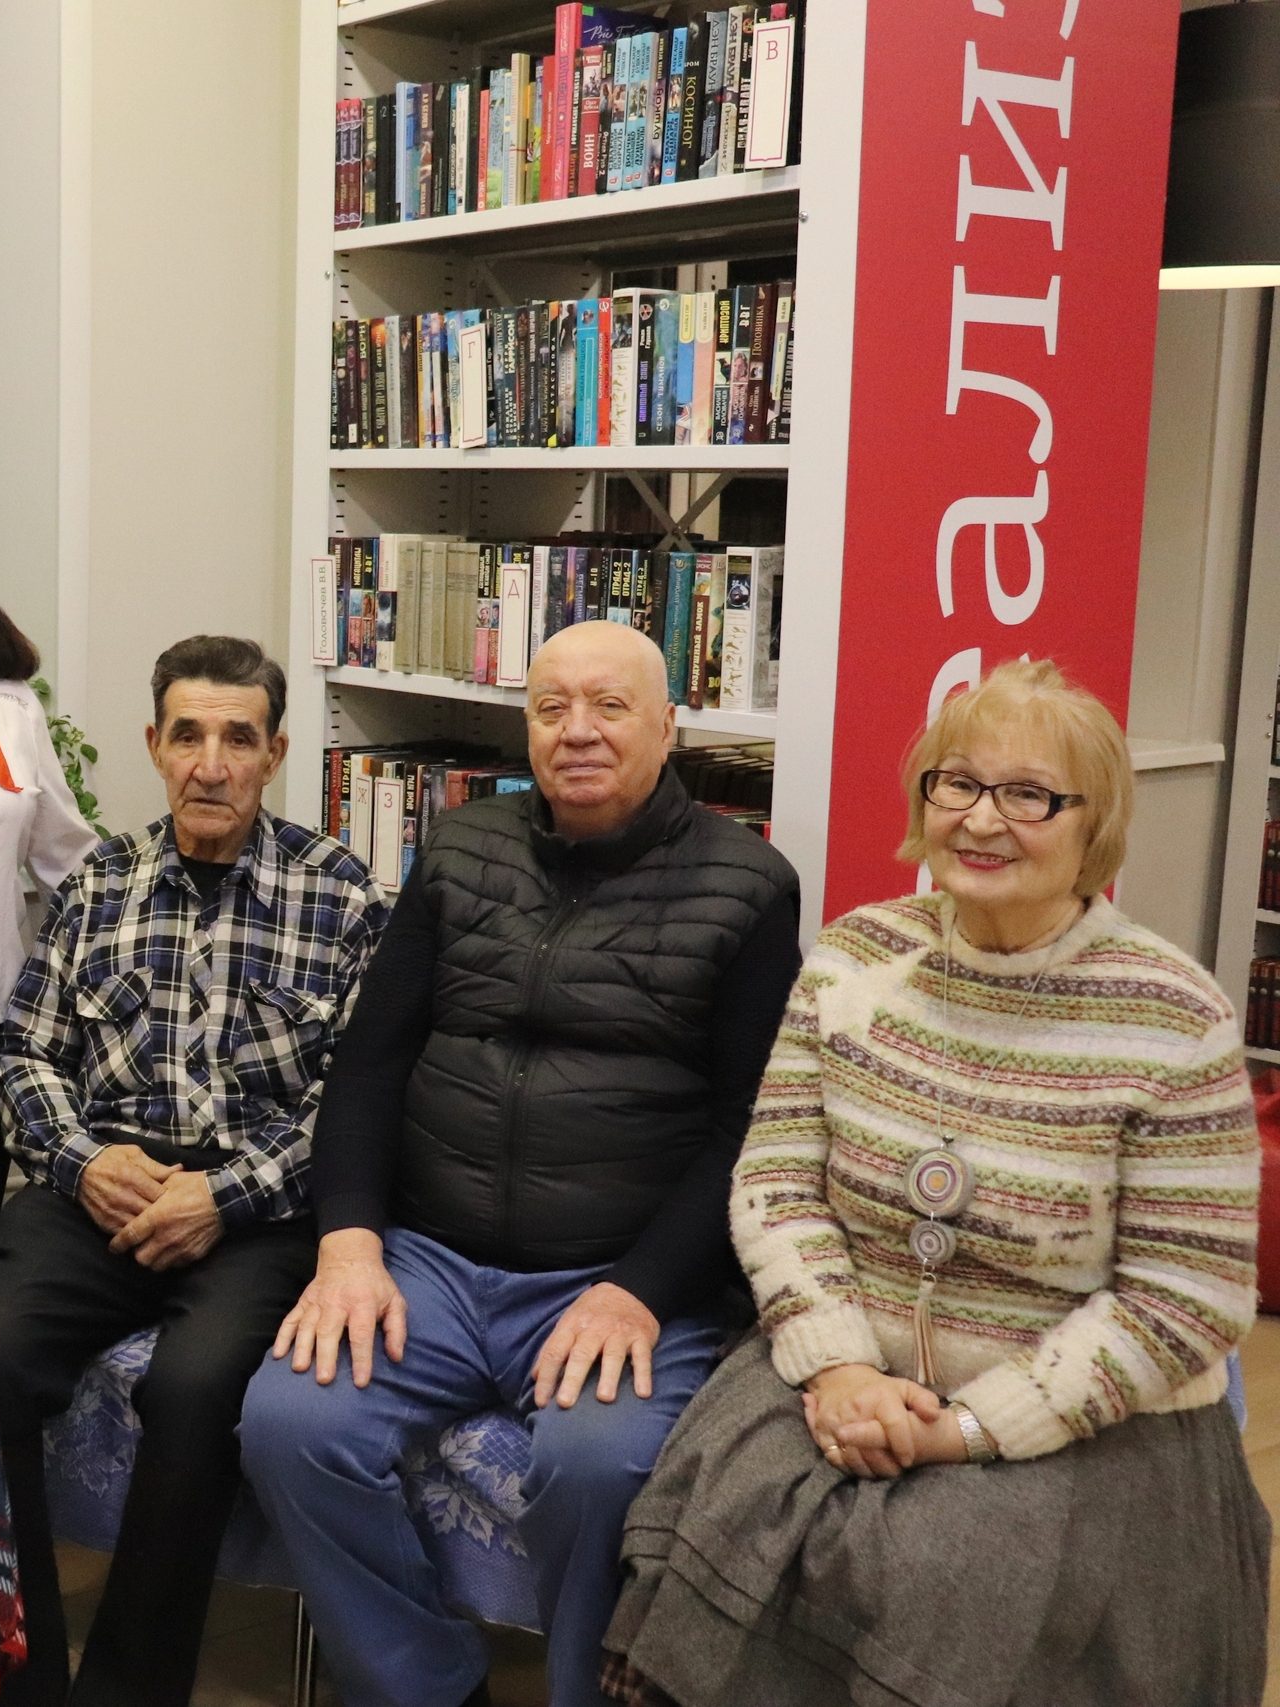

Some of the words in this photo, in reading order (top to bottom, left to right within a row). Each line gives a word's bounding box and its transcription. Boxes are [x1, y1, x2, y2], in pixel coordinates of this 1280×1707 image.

[712, 19, 720, 50] ДЭН
[729, 13, 738, 46] ДЭН
[726, 46, 737, 88] БРАУН
[766, 40, 778, 60] В
[708, 52, 718, 93] БРАУН
[682, 76, 697, 148] КОСИНОГ
[583, 134, 595, 168] ВОИН
[719, 300, 730, 344] КРИПТОЗОЙ
[468, 341, 475, 358] Г
[507, 319, 515, 373] ГАРРИСОН
[926, 0, 1082, 732] али
[656, 403, 664, 432] СЕЗОН
[508, 579, 520, 599] Д
[611, 562, 620, 596] ОТРЯД-2
[622, 562, 630, 597] ОТРЯД-2
[695, 601, 703, 631] ЗАМОК
[691, 634, 702, 691] ВОЗДУШНЫЙ
[343, 759, 351, 794] ОТРЯД
[358, 787, 368, 804] Ж
